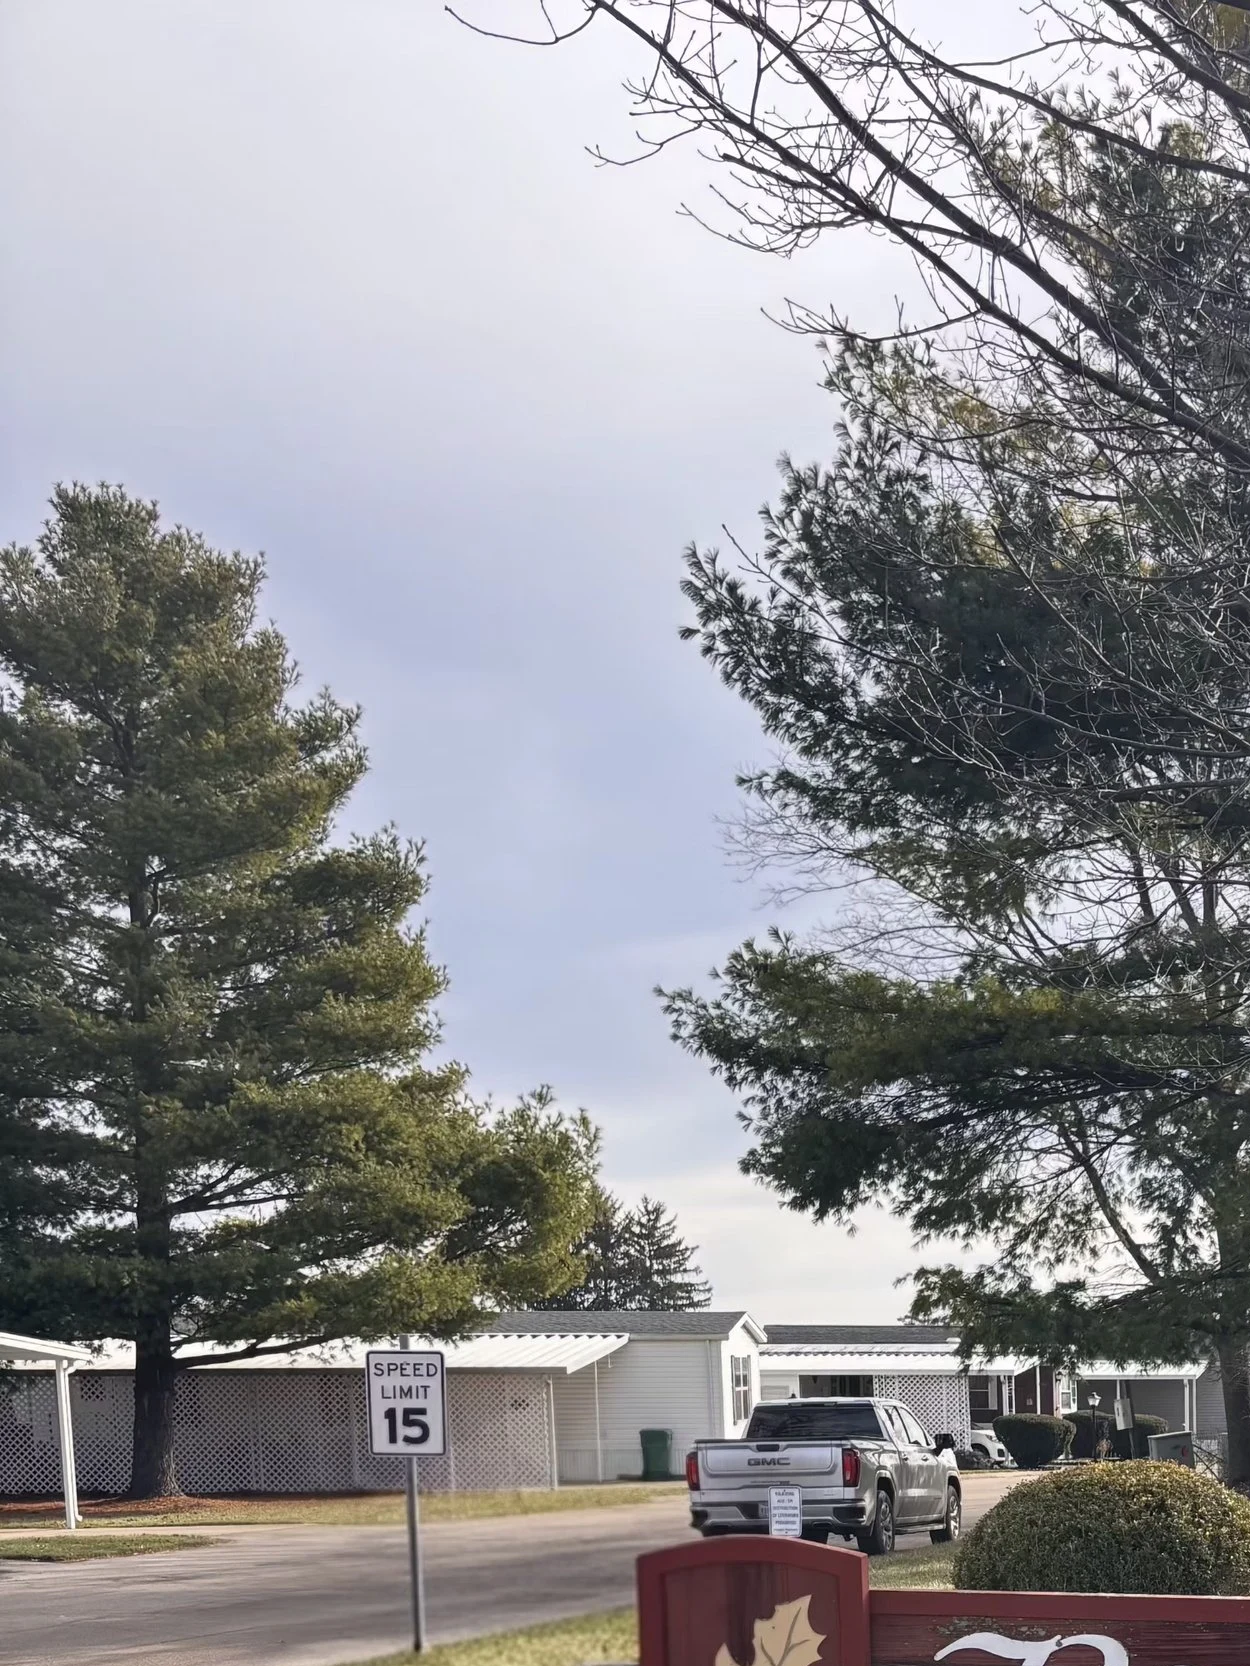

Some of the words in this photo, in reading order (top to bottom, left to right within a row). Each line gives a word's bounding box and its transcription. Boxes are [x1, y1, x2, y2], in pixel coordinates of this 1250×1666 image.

[373, 1362, 438, 1378] SPEED
[381, 1385, 431, 1400] LIMIT
[383, 1407, 431, 1445] 15
[747, 1457, 791, 1467] GMC
